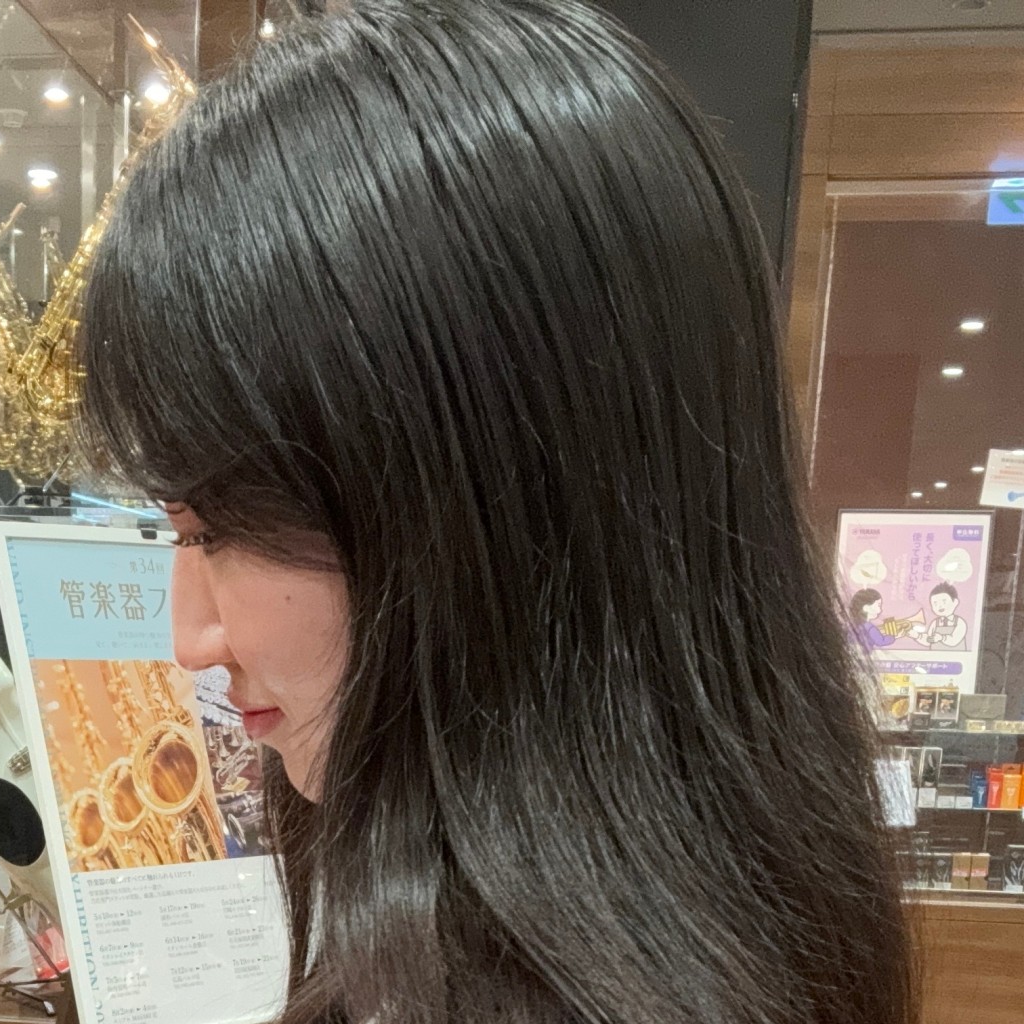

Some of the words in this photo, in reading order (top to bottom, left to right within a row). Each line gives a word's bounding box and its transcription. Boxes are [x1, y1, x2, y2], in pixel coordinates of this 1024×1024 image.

[129, 557, 165, 576] 第34回
[59, 578, 167, 621] 管楽器フ
